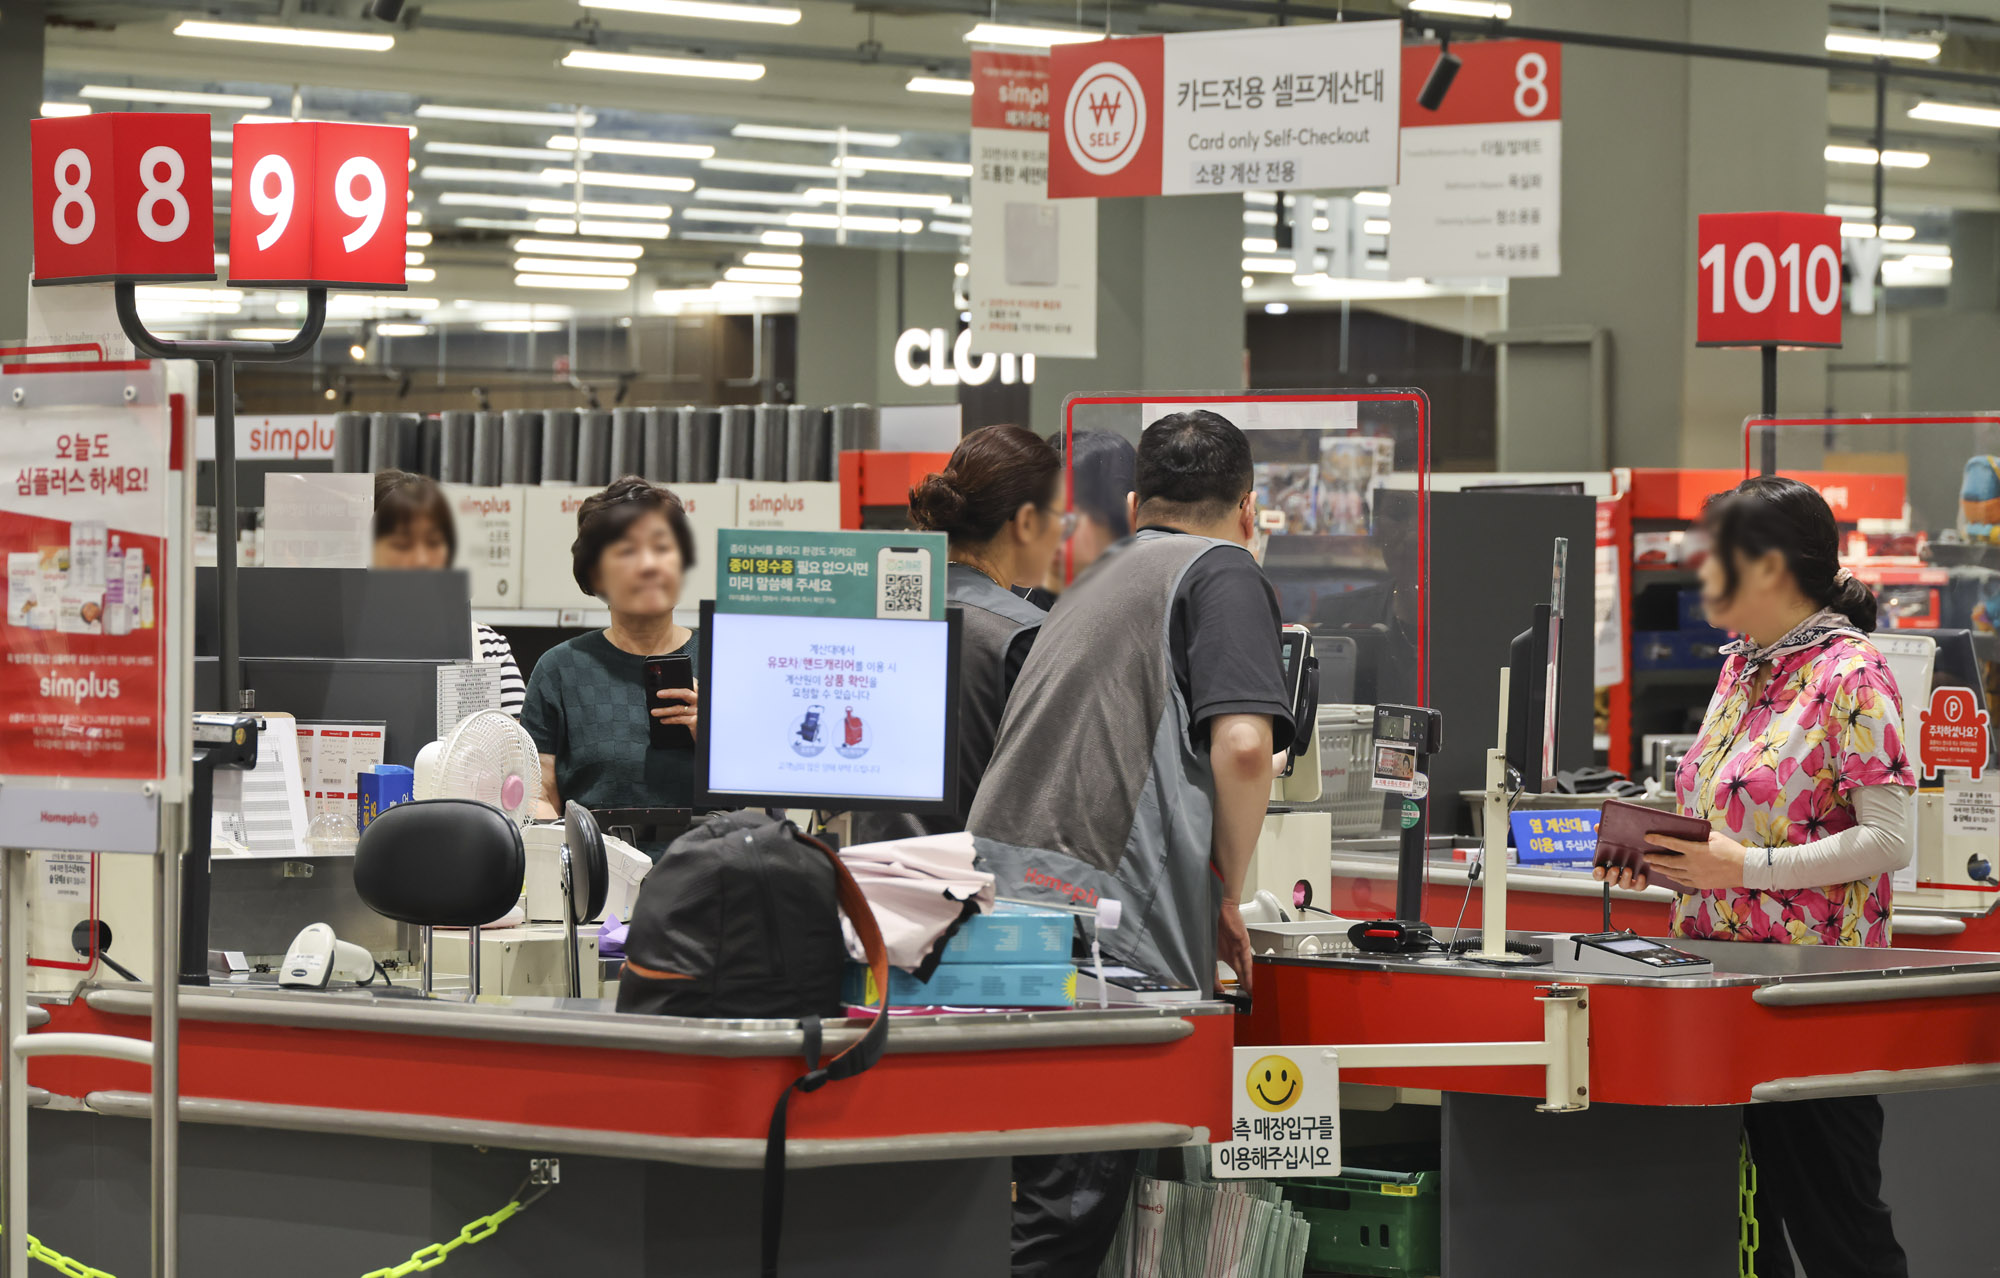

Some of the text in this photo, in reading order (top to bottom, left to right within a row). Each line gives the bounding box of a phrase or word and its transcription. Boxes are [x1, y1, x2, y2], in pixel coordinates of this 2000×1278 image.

[1177, 69, 1384, 111] 카드전용 셀프계산대
[1514, 52, 1548, 117] 8
[1089, 132, 1121, 148] SELF
[1188, 127, 1370, 153] Card only Self-Checkout
[1196, 160, 1296, 185] 소량 계산 전용
[52, 148, 96, 245] 8
[137, 146, 190, 243] 8
[250, 154, 295, 252] 9
[334, 156, 386, 253] 9
[1700, 242, 1776, 313] 10
[1779, 243, 1840, 315] 10
[56, 434, 109, 461] 오늘도
[16, 467, 148, 496] 심플러스 하세요!
[749, 494, 805, 516] simplus
[729, 558, 754, 573] 종이
[756, 559, 793, 575] 영수증
[797, 560, 820, 575] 필요
[822, 561, 869, 577] 없으시면
[729, 576, 833, 592] 미리 말씀해 주세요
[810, 644, 855, 656] 계산대에서
[866, 661, 884, 673] 이용
[888, 662, 896, 673] 시
[40, 671, 120, 704] simplus
[785, 674, 877, 688] 계산원이 상품 확인을
[792, 688, 870, 700] 요청할 수 있습니다
[1929, 725, 1978, 738] 주차하셨나요?
[40, 811, 87, 826] Homeplus
[1529, 817, 1591, 833] 옆 계산대를
[1530, 837, 1564, 853] 이용해
[1232, 1115, 1334, 1141] 측 매장입구를
[1220, 1145, 1331, 1171] 이용해주십시오
